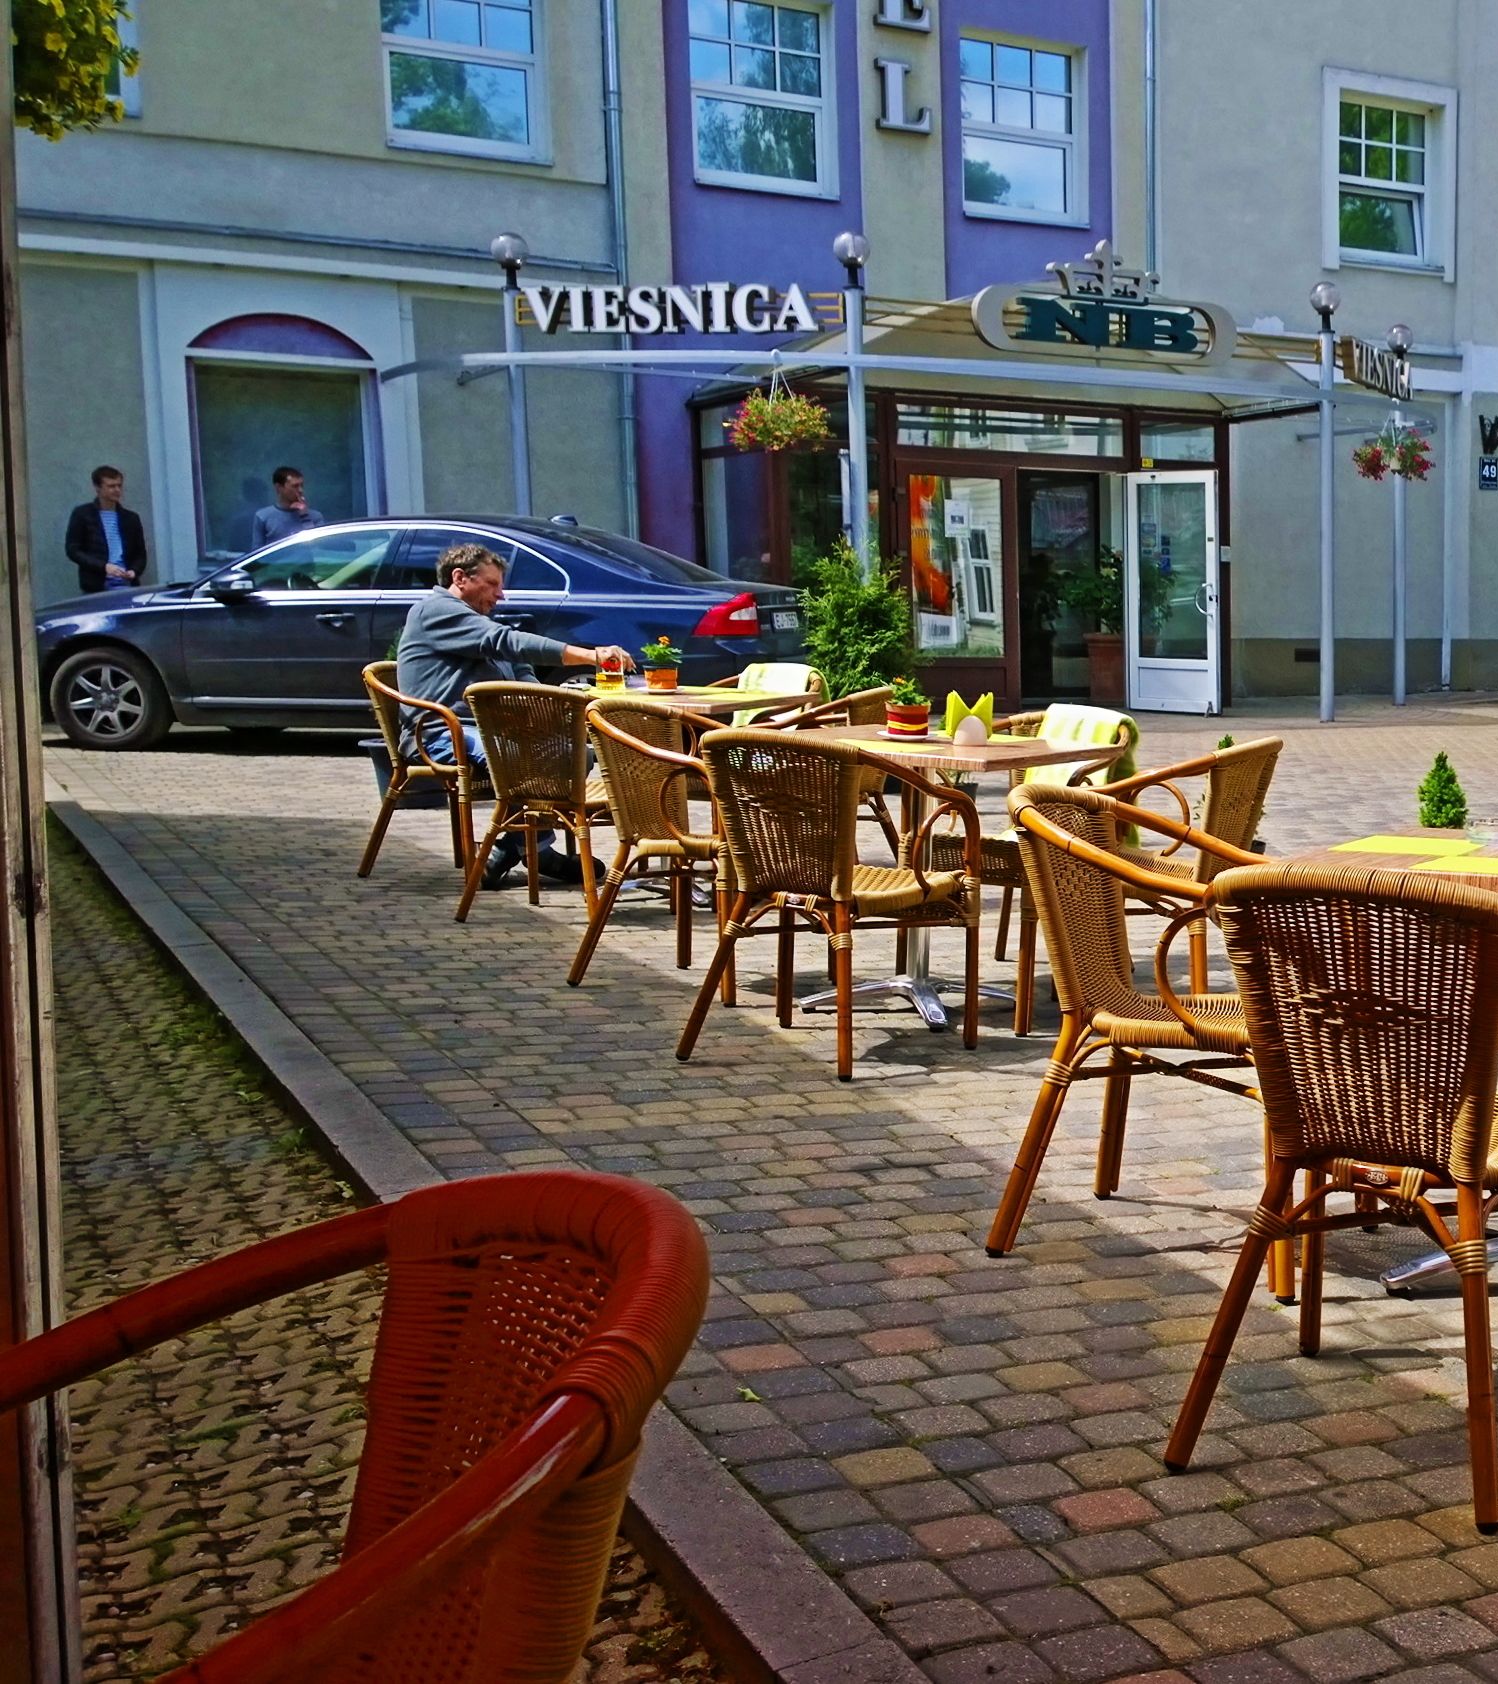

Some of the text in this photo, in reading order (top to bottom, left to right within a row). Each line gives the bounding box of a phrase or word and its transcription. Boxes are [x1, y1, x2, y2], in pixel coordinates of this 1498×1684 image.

[521, 281, 820, 334] VIESNICA
[1011, 296, 1199, 352] NB
[1351, 336, 1413, 400] VIESNICA
[1482, 464, 1497, 478] 49
